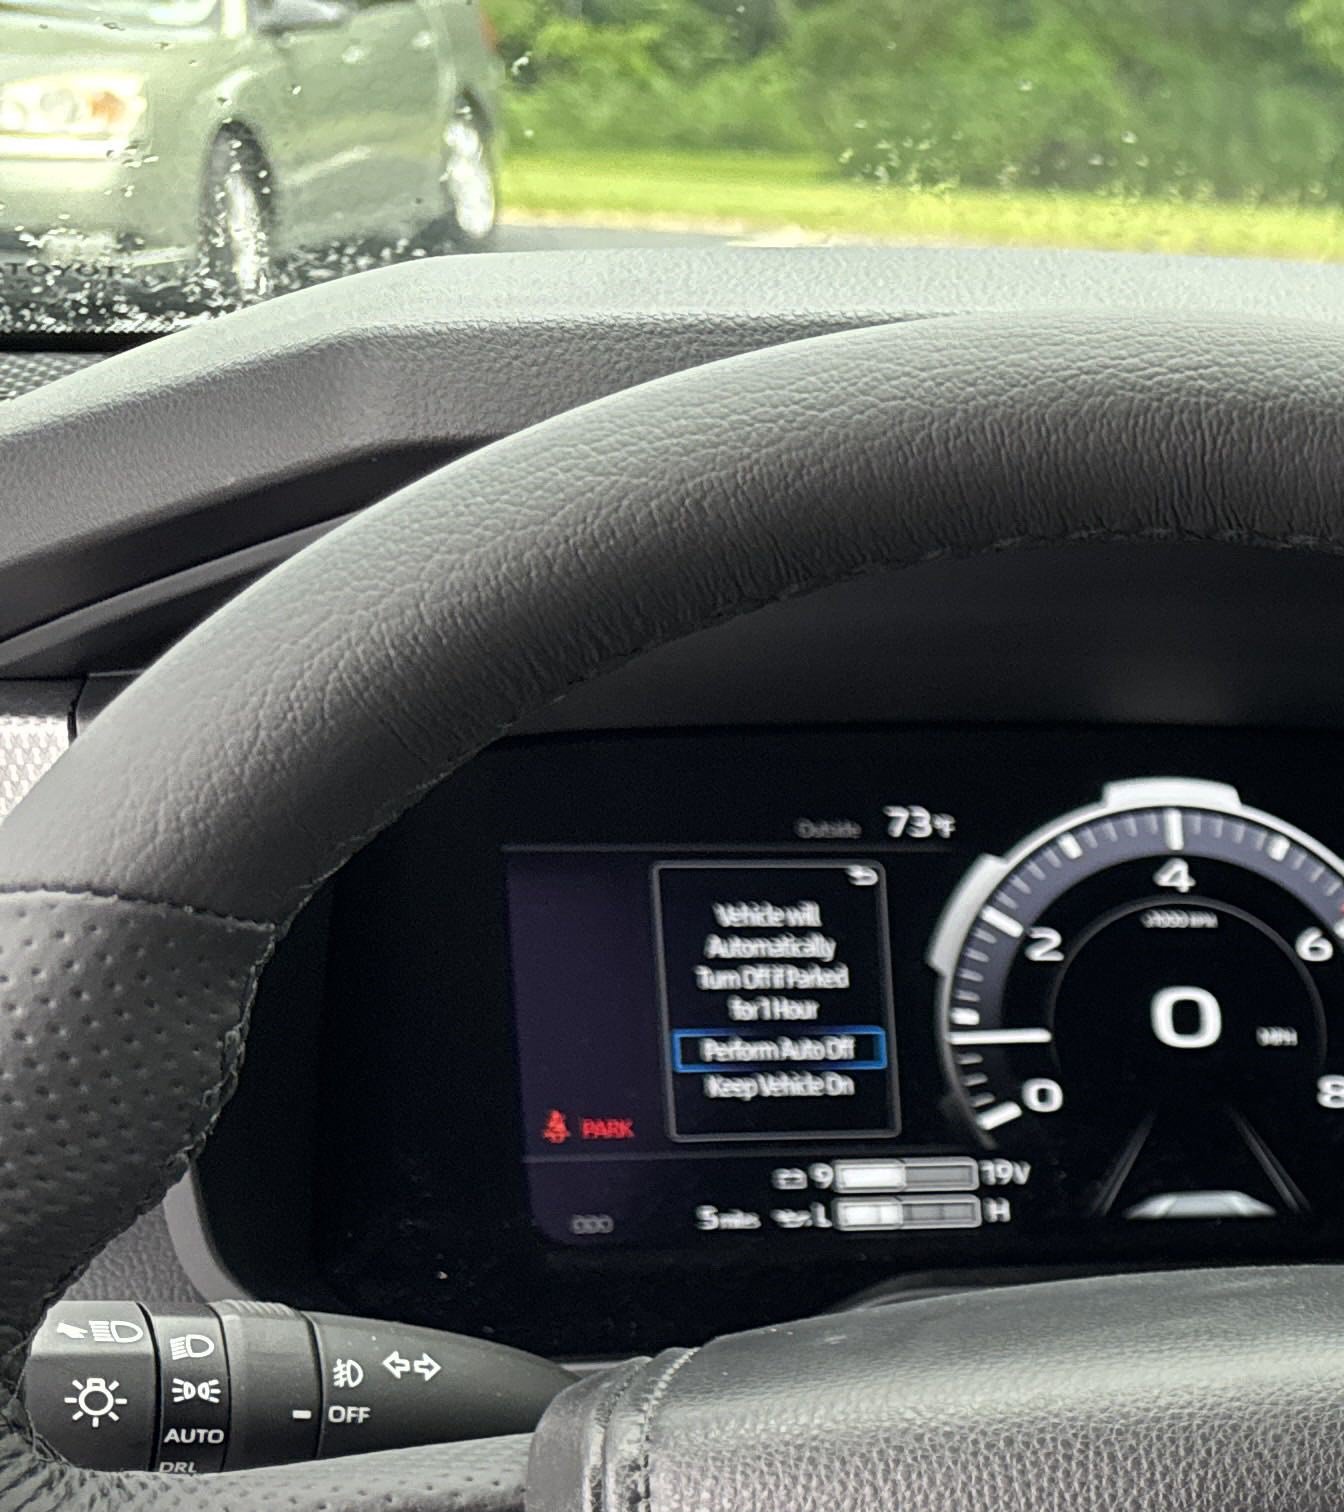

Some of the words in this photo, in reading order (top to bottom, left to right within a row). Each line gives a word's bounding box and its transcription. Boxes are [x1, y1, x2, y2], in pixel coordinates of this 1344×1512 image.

[4, 262, 134, 278] TOYOT
[1153, 857, 1197, 893] 4
[712, 901, 785, 928] Vehicle
[785, 901, 822, 928] will
[704, 932, 838, 962] Automatically
[1025, 927, 1064, 962] 2
[1296, 926, 1335, 962] 6
[694, 964, 740, 990] Turn
[740, 963, 769, 990] Off
[785, 962, 850, 989] Parked
[727, 994, 758, 1021] for
[772, 996, 820, 1020] Hour
[1150, 985, 1222, 1049] 0
[701, 1036, 779, 1062] Perform
[778, 1035, 825, 1061] Auto
[824, 1035, 856, 1060] Off
[704, 1073, 757, 1101] Keep
[756, 1071, 824, 1097] Vehicle
[823, 1071, 856, 1096] On
[1021, 1077, 1064, 1113] 0
[581, 1118, 635, 1140] PARK
[808, 1162, 833, 1189] 9
[981, 1196, 1012, 1223] H
[327, 1405, 372, 1425] OFF
[163, 1426, 226, 1446] AUTO
[158, 1460, 198, 1474] DRL
